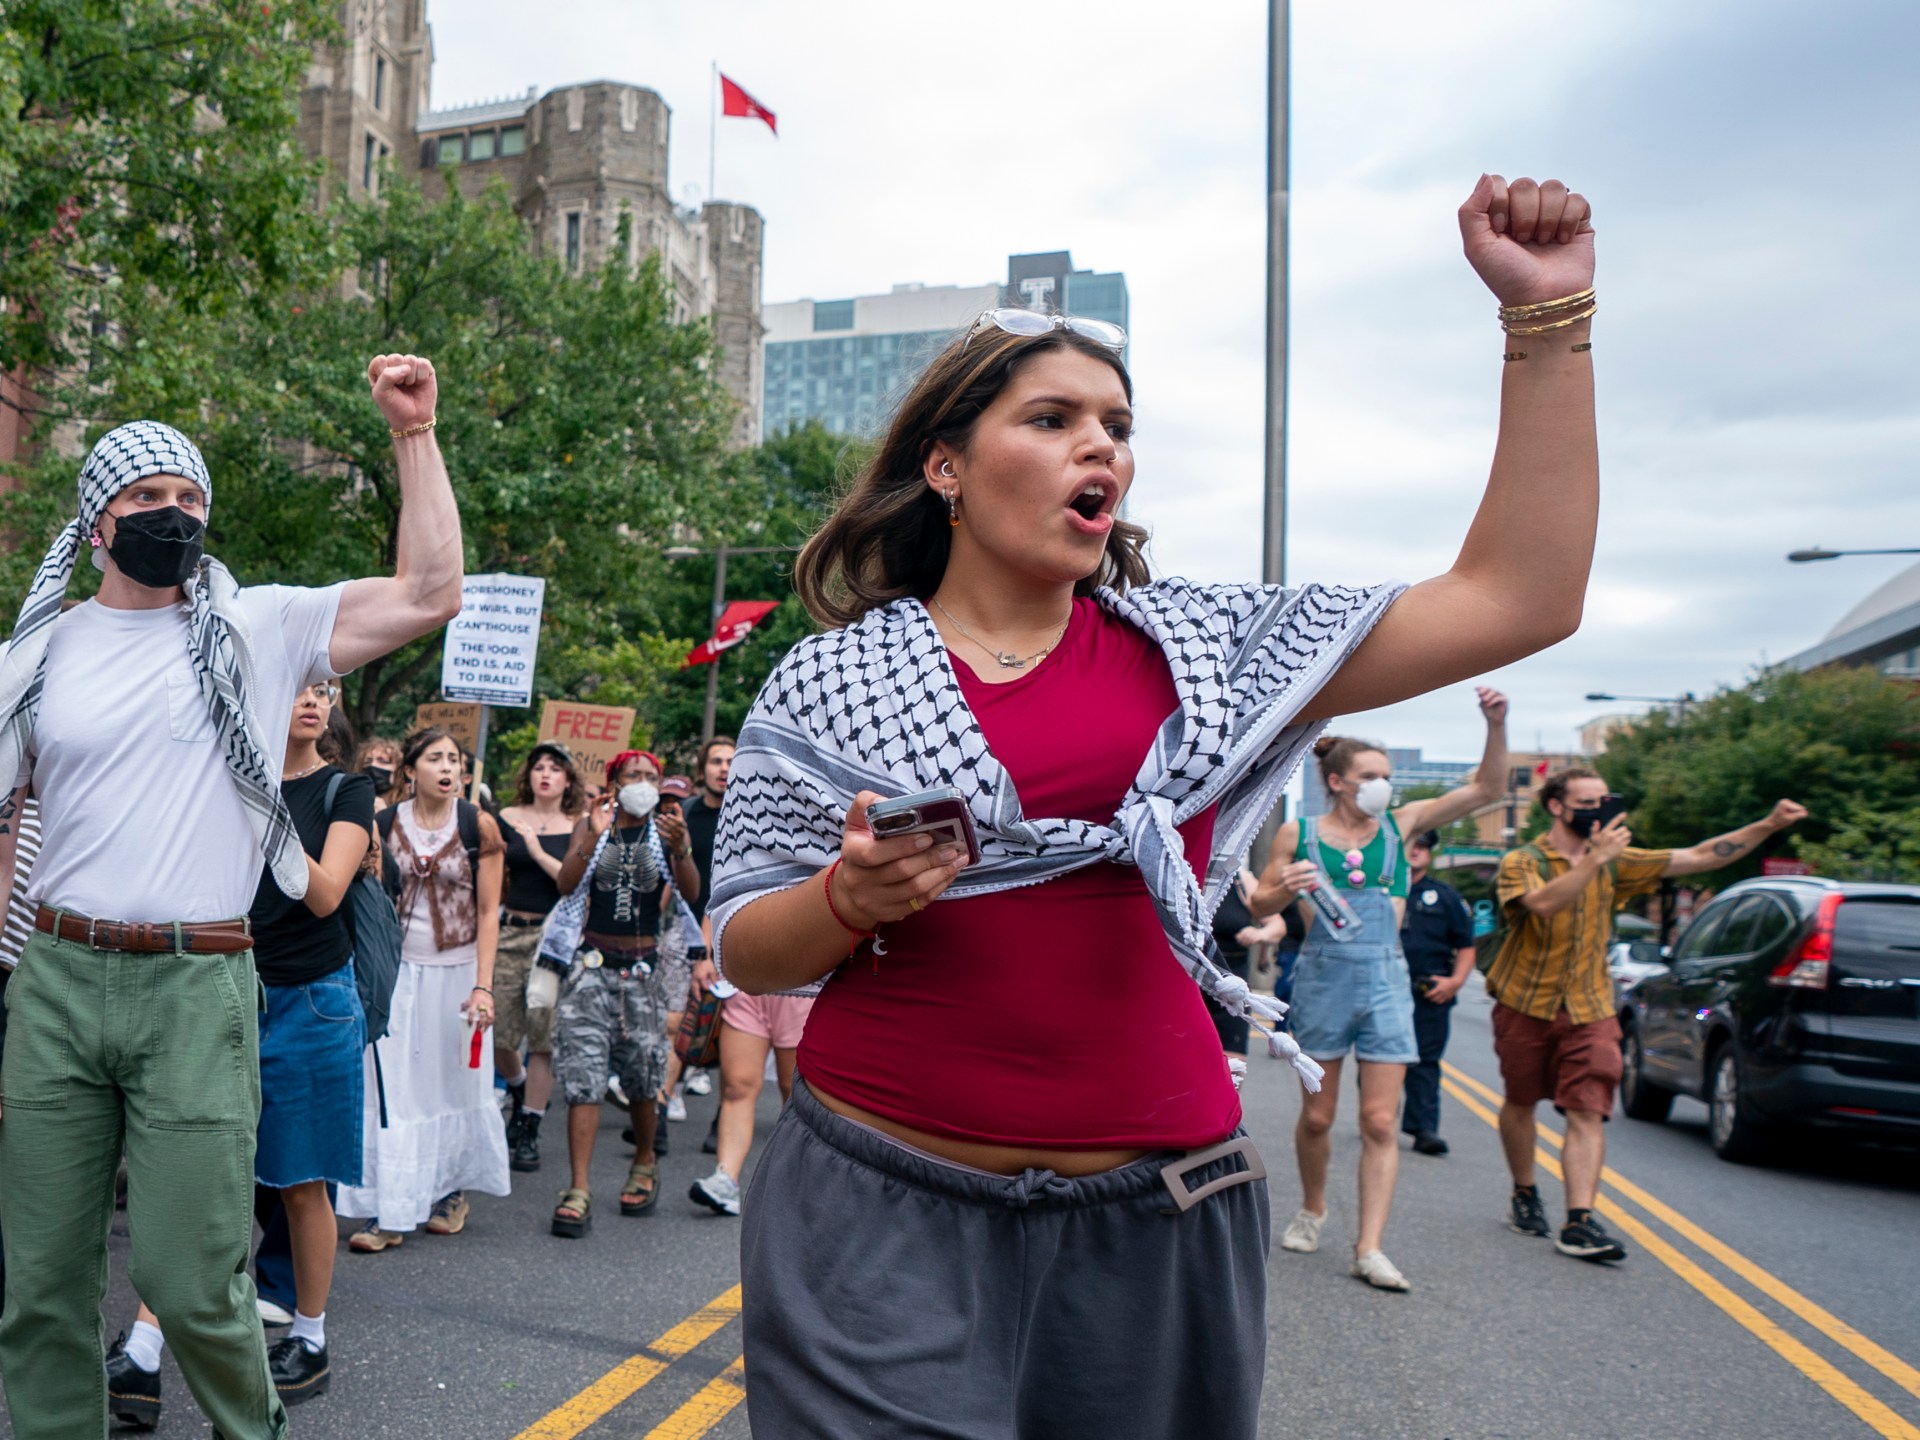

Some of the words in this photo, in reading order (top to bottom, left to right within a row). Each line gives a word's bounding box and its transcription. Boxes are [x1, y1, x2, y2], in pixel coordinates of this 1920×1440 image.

[515, 606, 537, 615] BUT
[461, 643, 483, 653] THE
[454, 656, 480, 667] END
[504, 661, 525, 671] AID
[459, 672, 474, 682] TO
[554, 710, 623, 742] FREE
